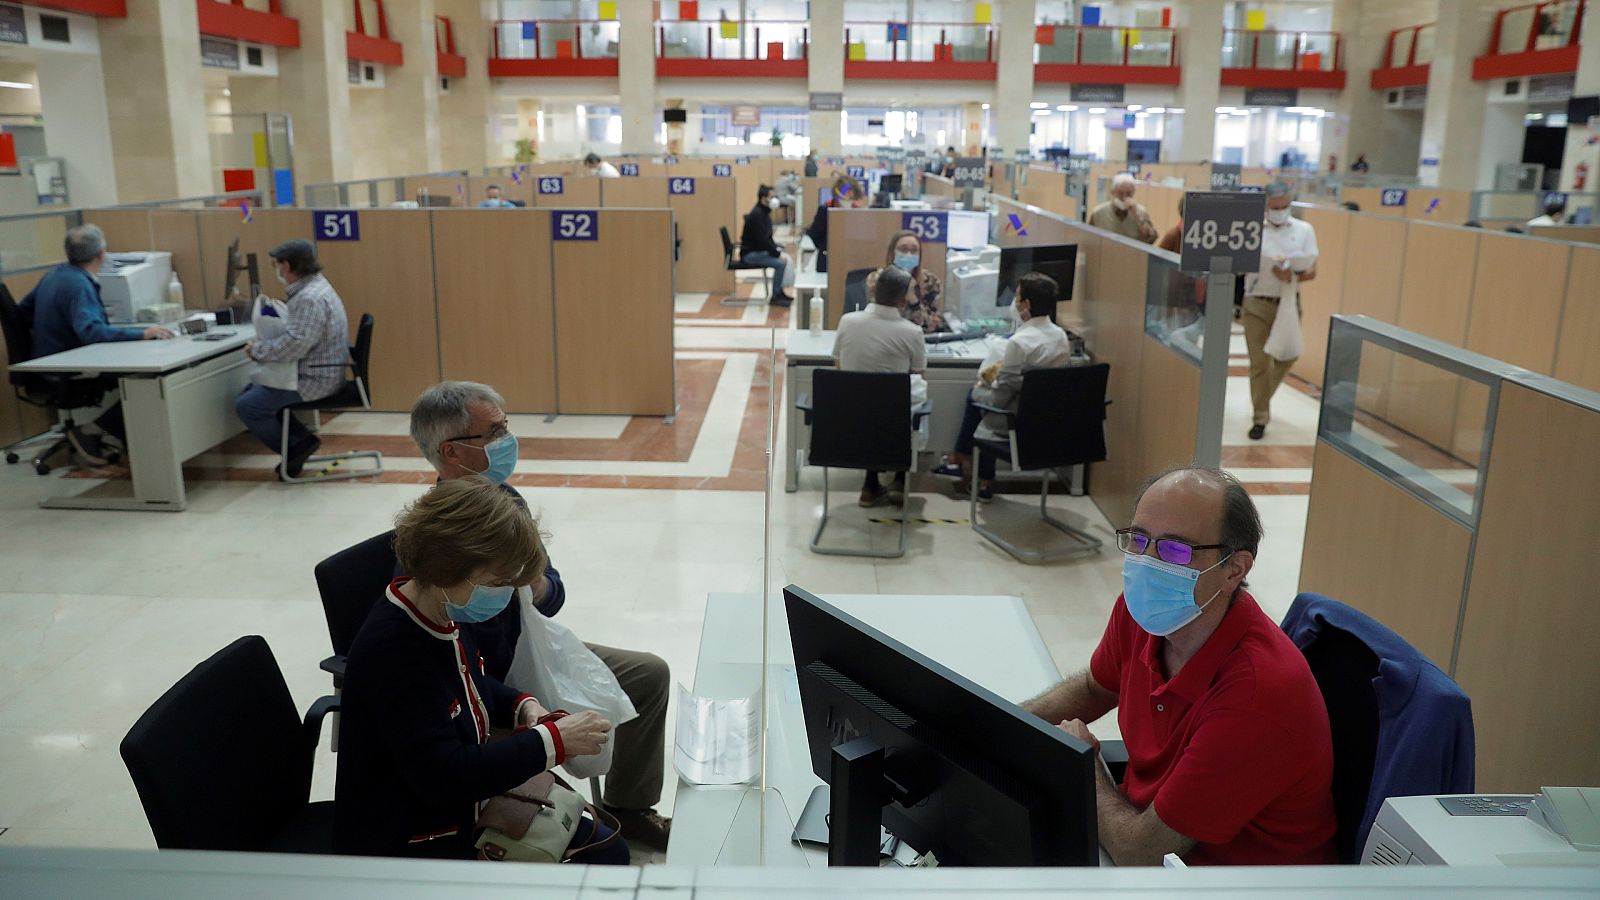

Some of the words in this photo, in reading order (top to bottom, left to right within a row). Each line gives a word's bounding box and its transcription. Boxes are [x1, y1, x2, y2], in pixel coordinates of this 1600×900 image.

[541, 178, 561, 193] 63
[672, 179, 692, 193] 64
[955, 167, 984, 181] 60-65
[324, 213, 352, 237] 51
[560, 213, 591, 237] 52
[910, 215, 940, 239] 53
[1184, 219, 1261, 251] 48-53
